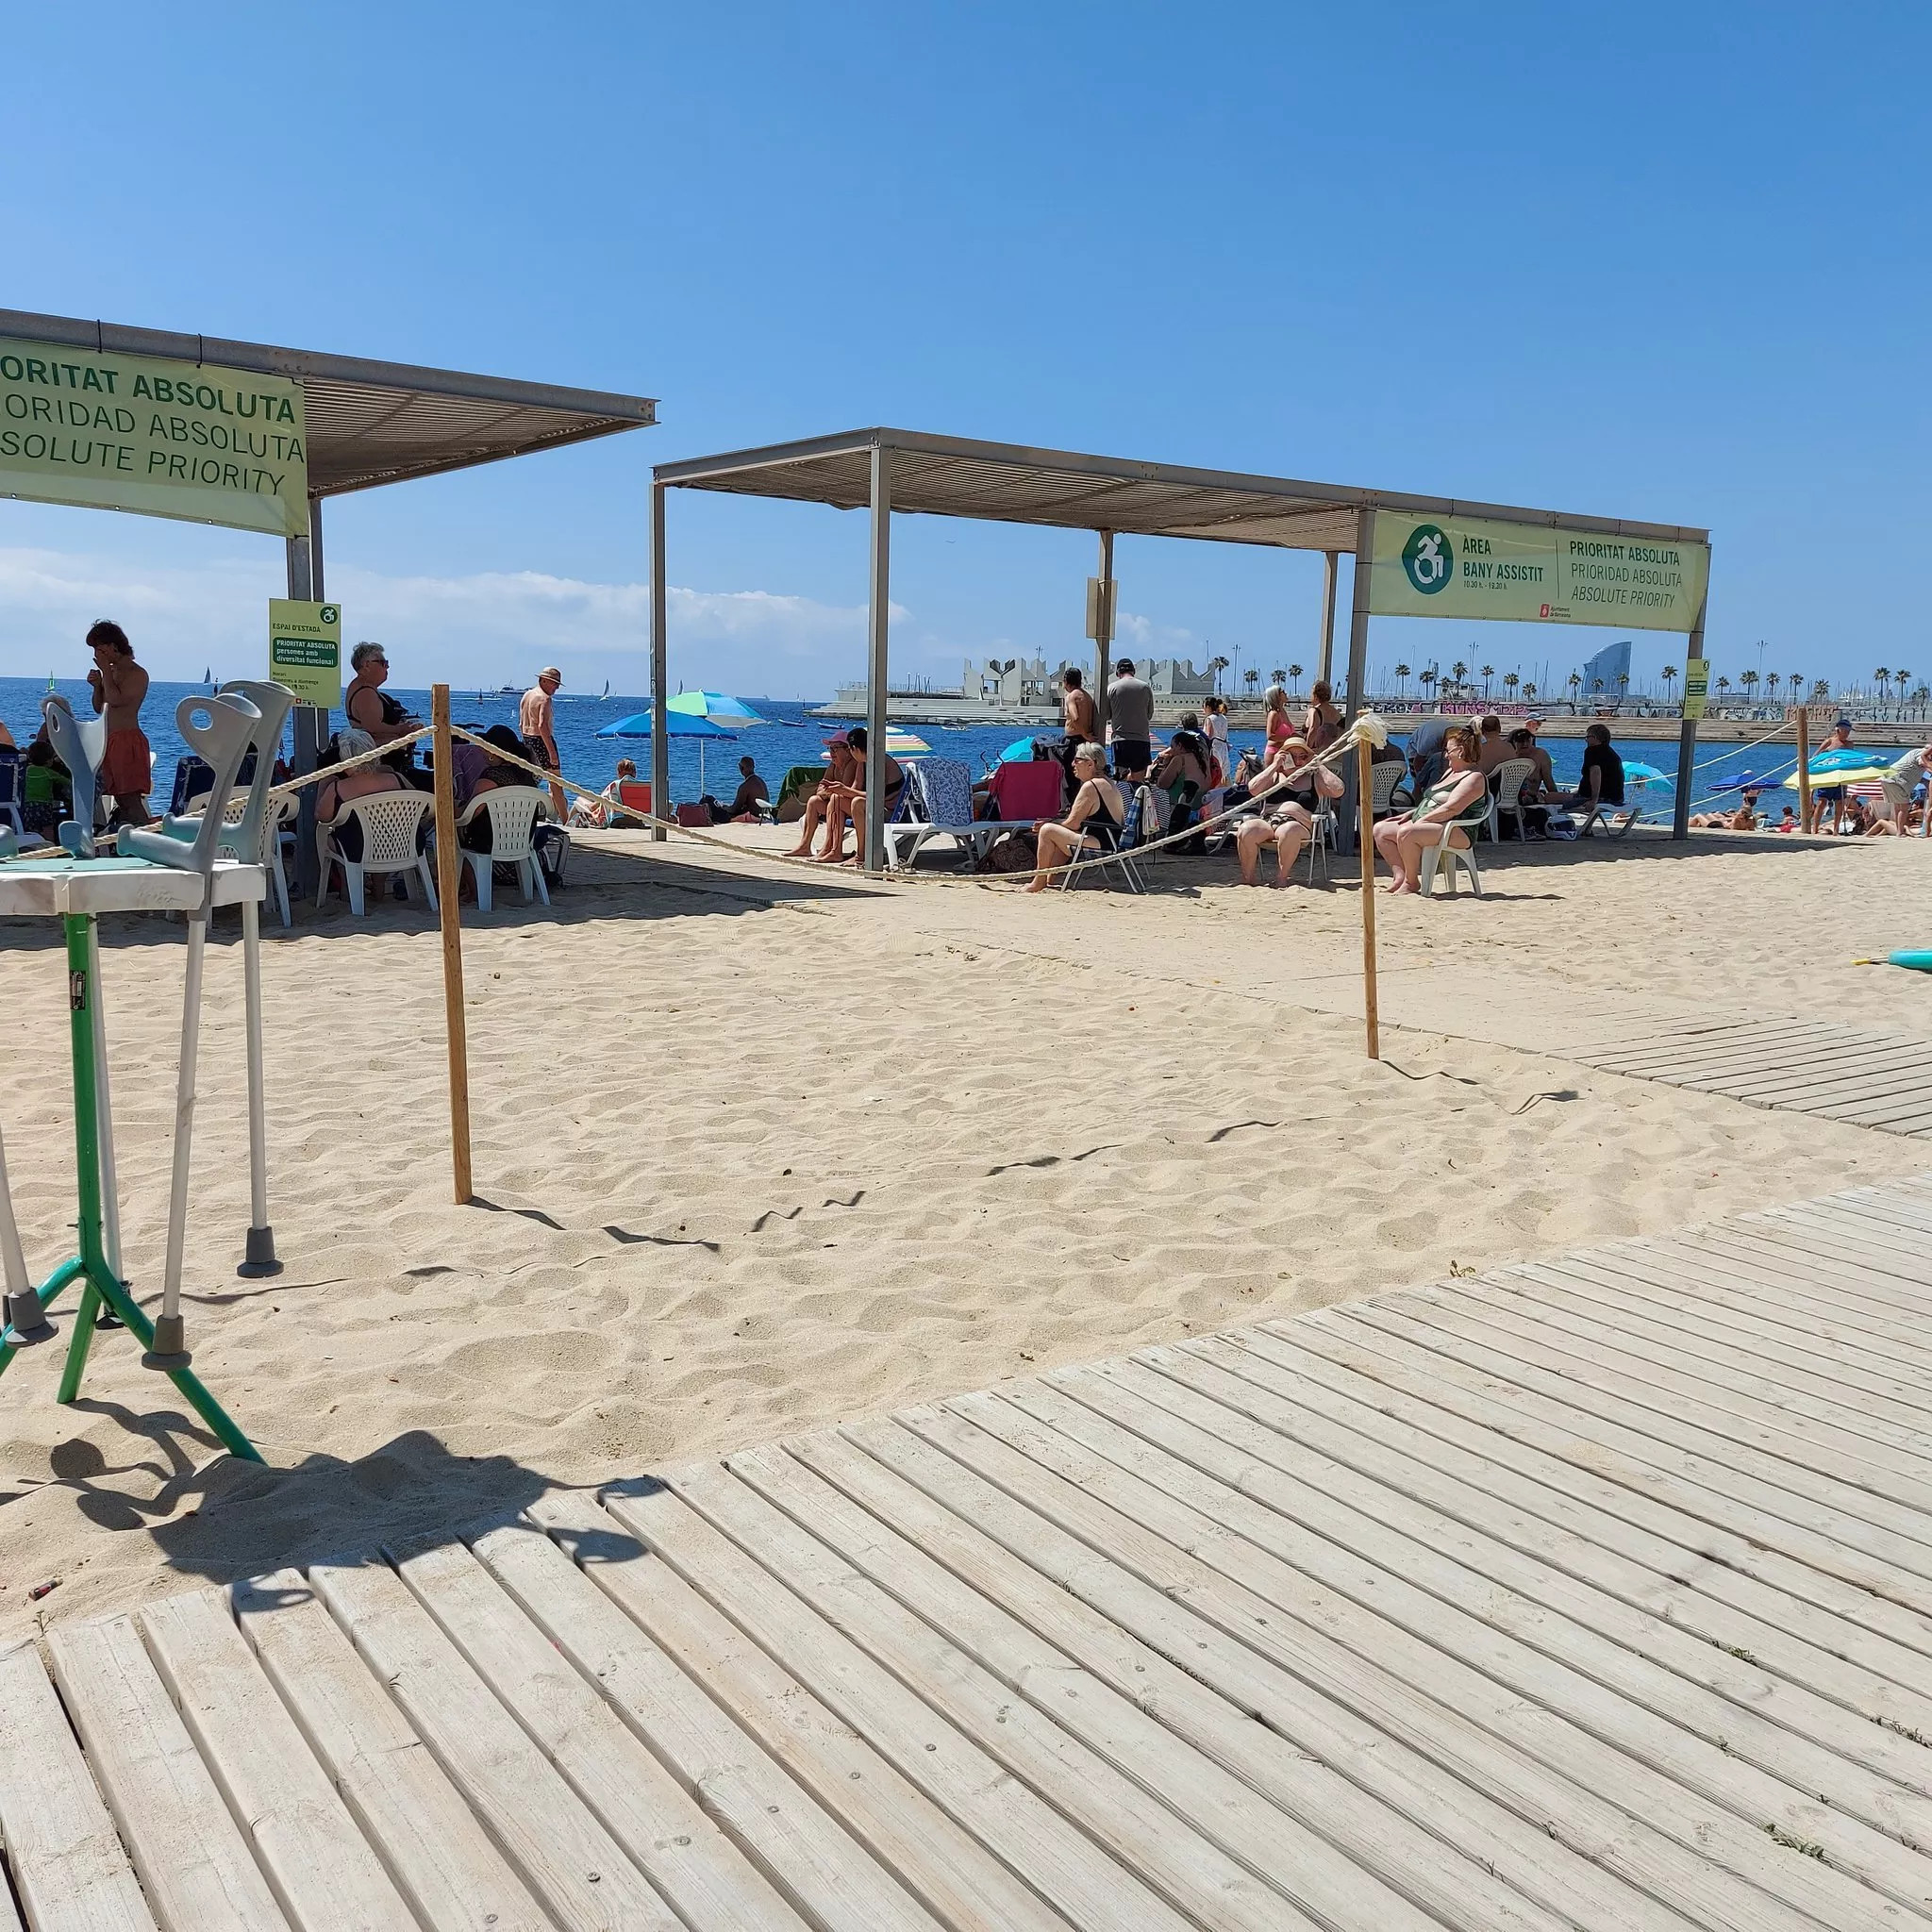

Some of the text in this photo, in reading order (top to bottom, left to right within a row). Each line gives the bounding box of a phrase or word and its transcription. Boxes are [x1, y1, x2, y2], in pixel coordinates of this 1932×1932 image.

[132, 374, 296, 425] ABSOLUTA
[148, 413, 305, 464] ABSOLUTA
[147, 450, 286, 496] PRIORITY
[1462, 534, 1491, 555] ÀREA
[1570, 541, 1680, 566] PRIORITAT ABSOLUTA
[1463, 561, 1543, 582] BANY ASSISTIT
[1571, 562, 1683, 588] PRIORIDAD ABSOLUTA
[1571, 586, 1675, 608] ABSOLUTE PRIORITY
[292, 624, 321, 633] D'ESTADA
[276, 640, 336, 650] PRIORITAT ABSOLUTA
[306, 657, 334, 665] funcional
